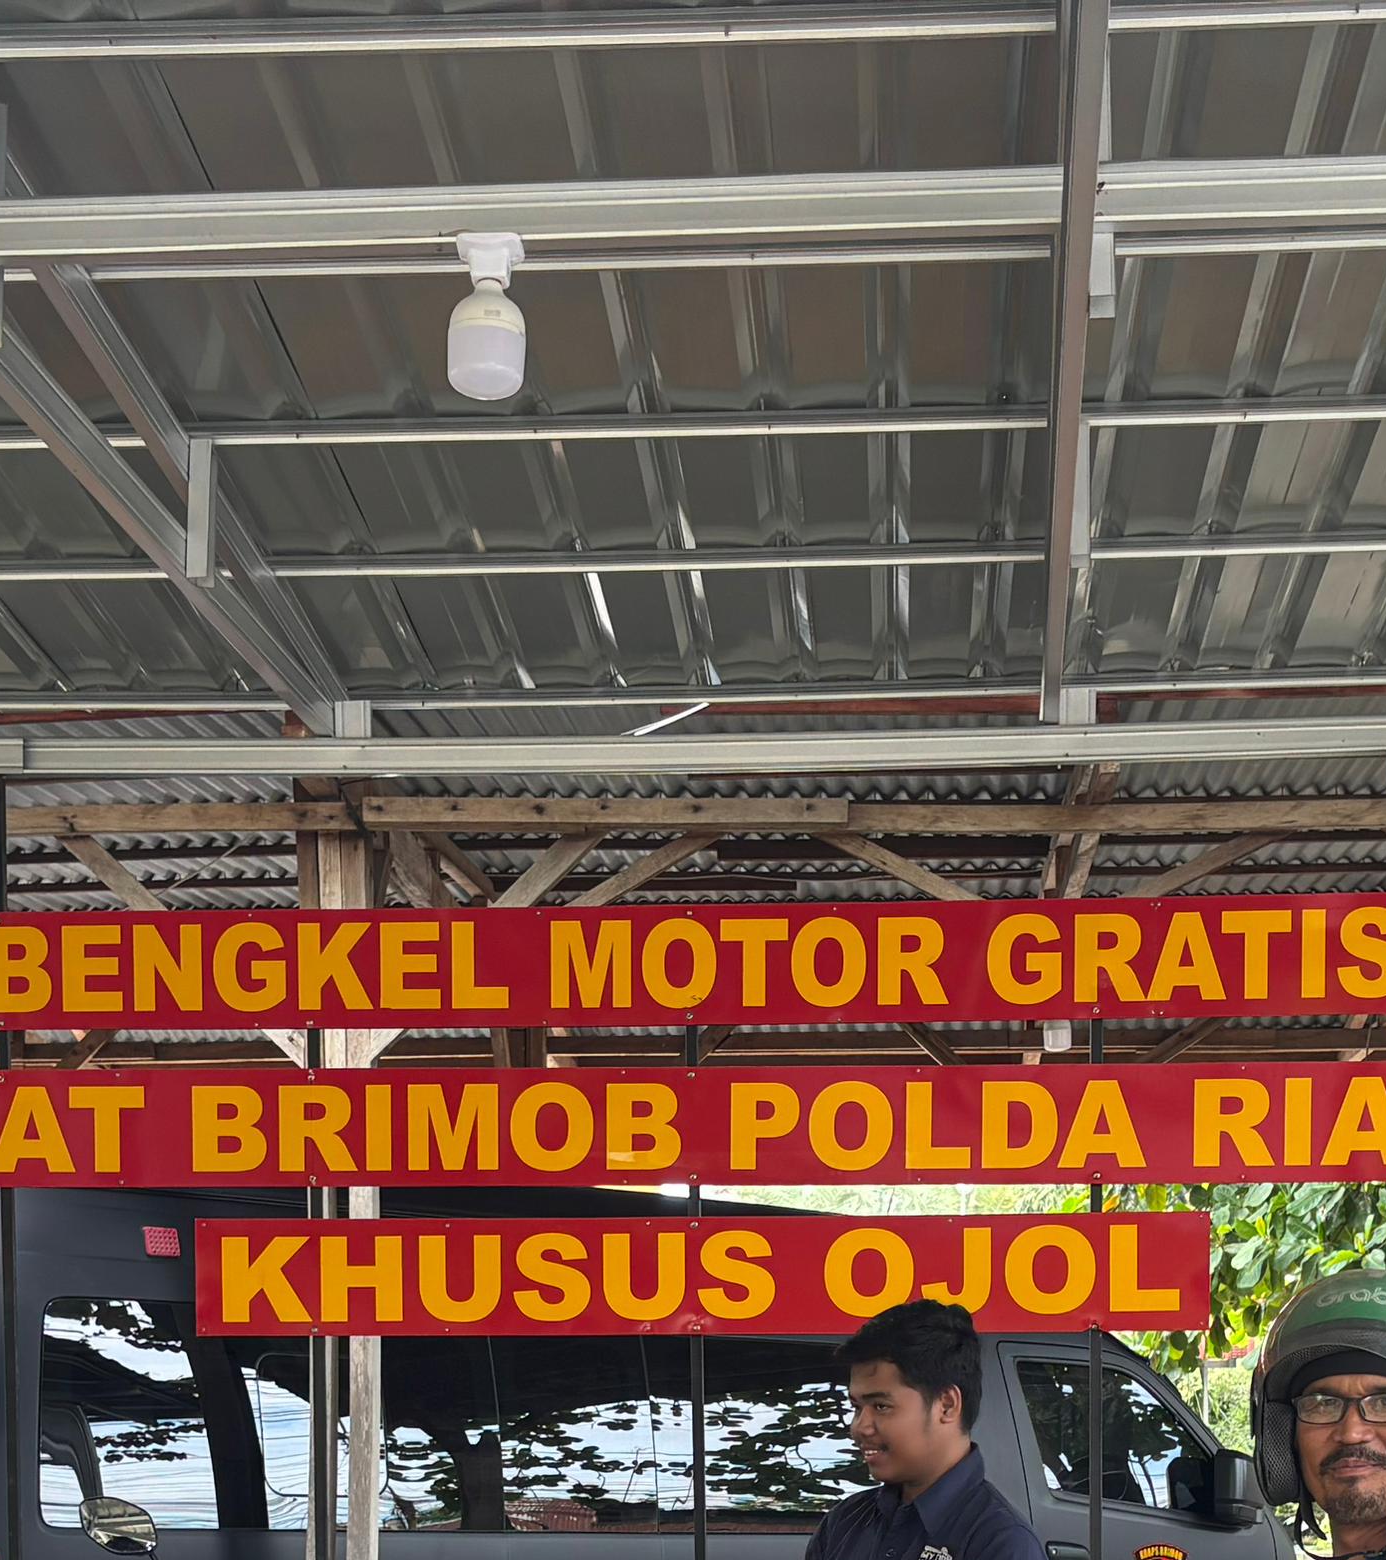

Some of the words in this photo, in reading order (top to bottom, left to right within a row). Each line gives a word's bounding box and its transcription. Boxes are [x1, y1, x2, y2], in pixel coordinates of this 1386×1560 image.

[550, 916, 950, 1010] MOTOR
[191, 1081, 682, 1174] BRIMOB
[729, 1079, 1147, 1172] POLDA
[221, 1229, 777, 1324] KHUSUS
[823, 1223, 1182, 1319] OJOL
